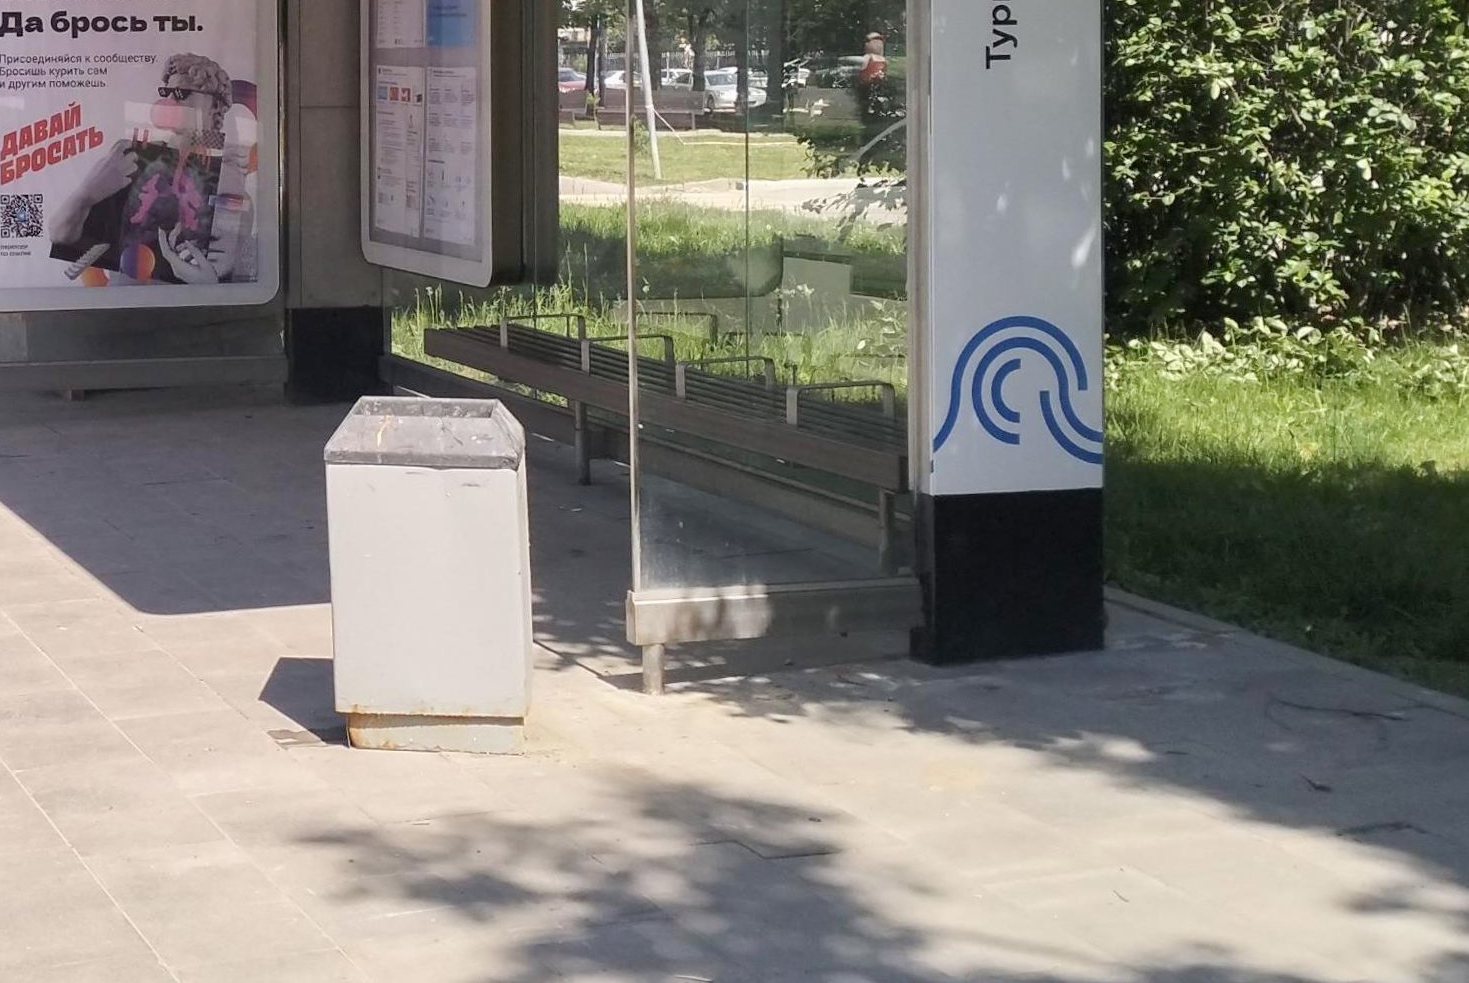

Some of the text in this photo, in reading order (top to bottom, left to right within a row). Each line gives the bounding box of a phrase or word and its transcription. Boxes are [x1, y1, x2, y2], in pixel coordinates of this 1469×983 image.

[49, 10, 148, 39] брось
[152, 15, 204, 32] ты.
[84, 55, 91, 64] к
[49, 67, 85, 78] курить
[87, 67, 108, 76] сам
[8, 80, 47, 91] другим
[0, 101, 82, 162] ДАВАЙ
[0, 126, 104, 186] БРОСАТЬ
